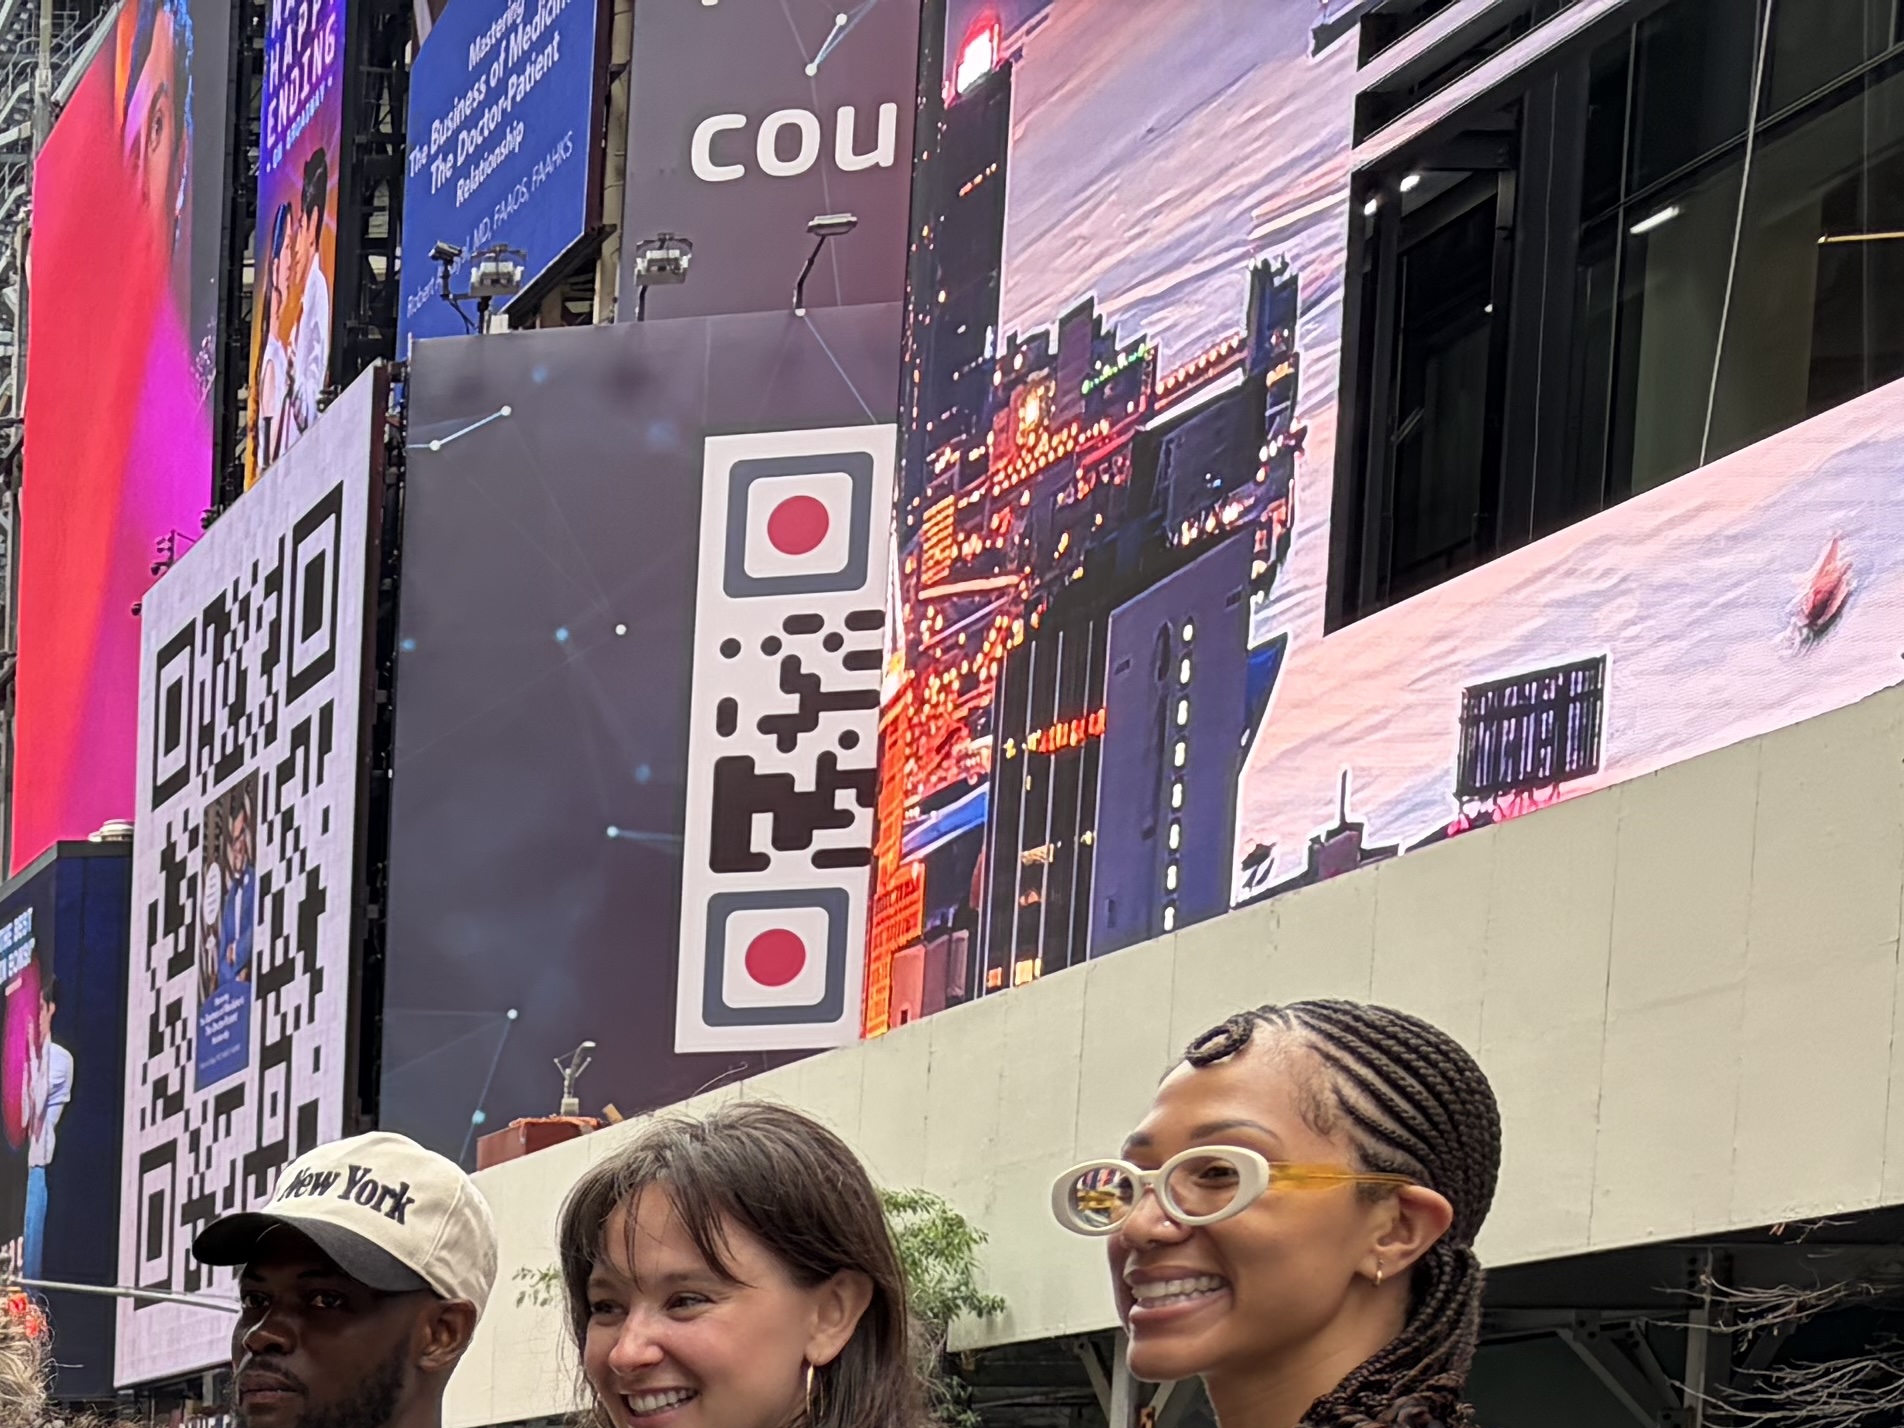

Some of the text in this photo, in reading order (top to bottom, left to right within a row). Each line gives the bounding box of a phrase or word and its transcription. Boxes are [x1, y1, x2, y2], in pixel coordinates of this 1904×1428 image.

[266, 11, 336, 149] ENDING
[409, 142, 429, 178] The
[430, 73, 487, 155] Business
[490, 38, 510, 88] of
[431, 30, 560, 195] The Doctor-Patient
[455, 120, 526, 208] Relationship
[690, 102, 899, 182] cou
[277, 1163, 416, 1225] New York
